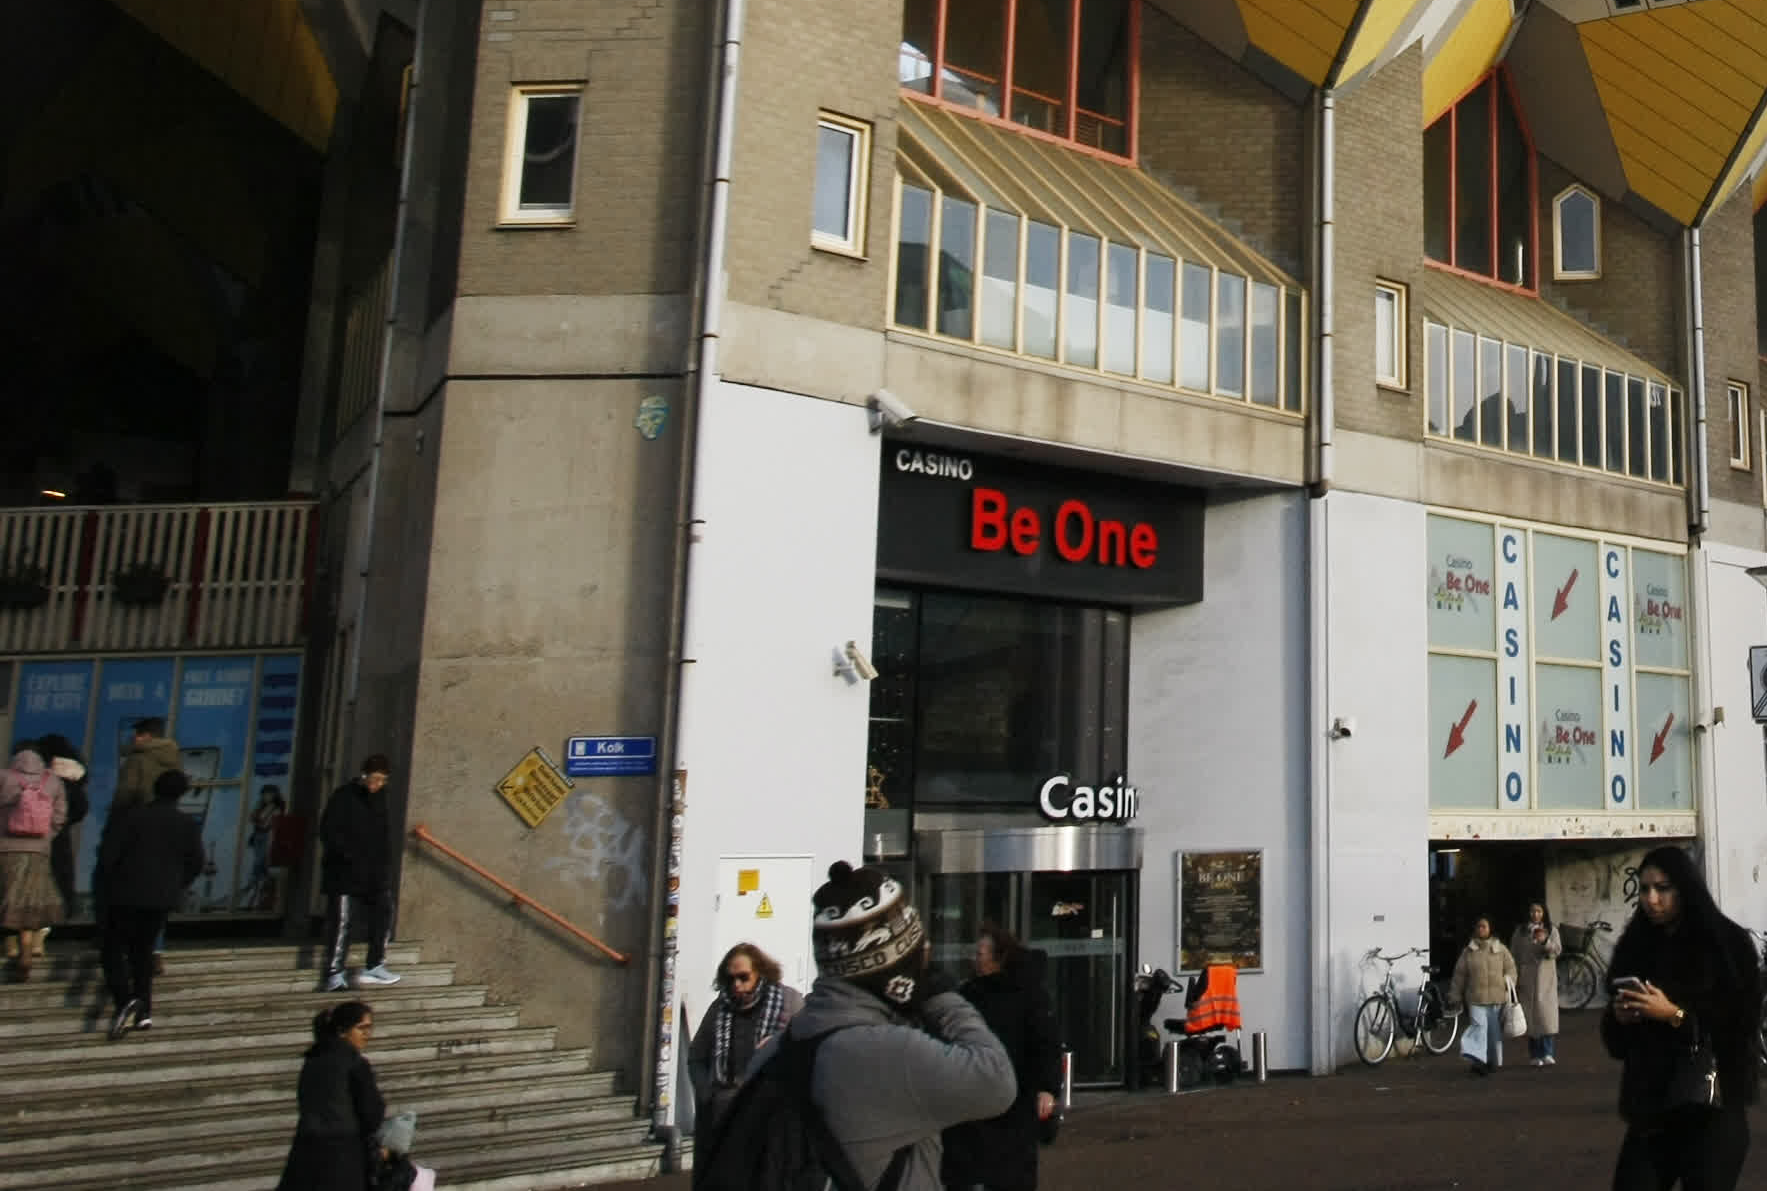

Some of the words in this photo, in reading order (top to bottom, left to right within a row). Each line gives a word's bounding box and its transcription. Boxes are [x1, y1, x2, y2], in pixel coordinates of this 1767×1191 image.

[896, 449, 973, 480] CASINO
[971, 487, 1041, 556] Be
[1055, 499, 1158, 568] One
[1446, 570, 1462, 592] Be
[1464, 573, 1490, 596] One
[1647, 598, 1660, 617] Be
[1502, 535, 1523, 802] CASINO
[1606, 551, 1627, 803] CASINO
[1555, 725, 1570, 745] Be
[1572, 726, 1596, 746] One
[1040, 775, 1139, 818] Casin
